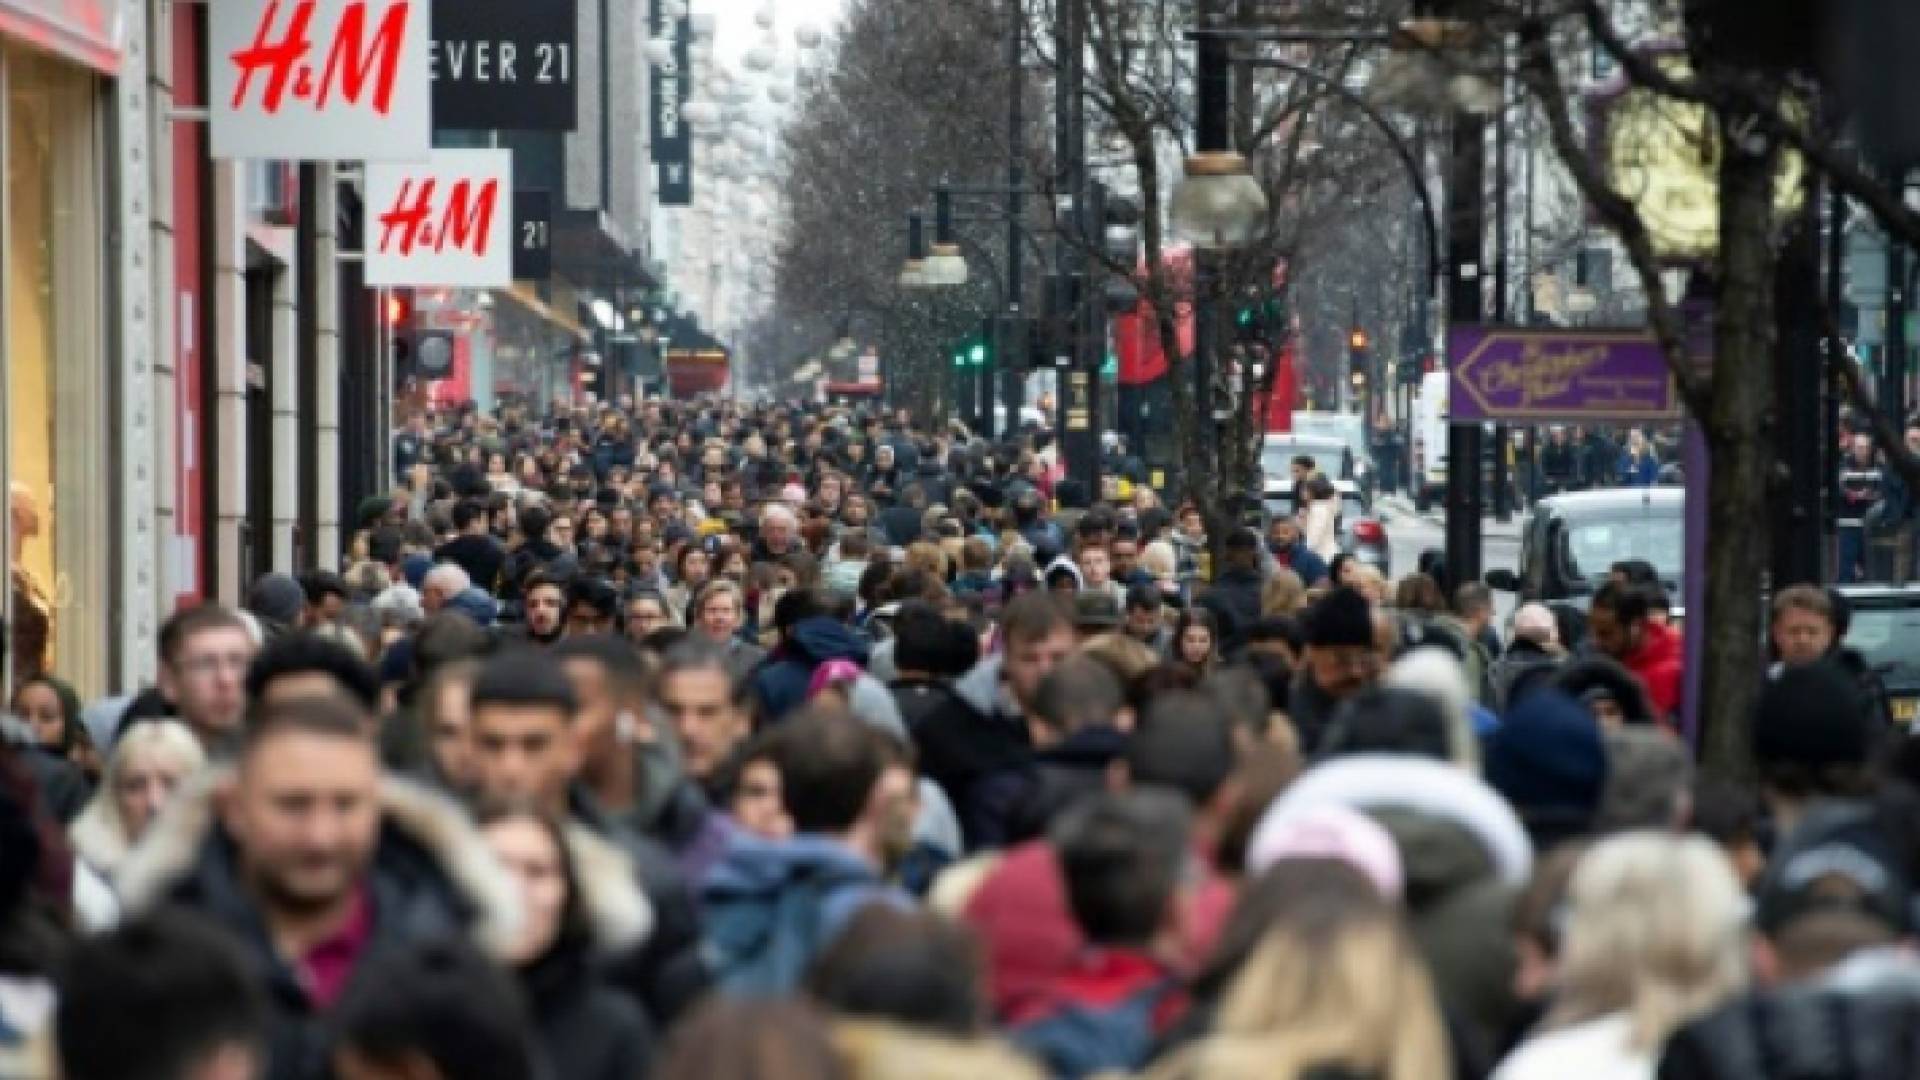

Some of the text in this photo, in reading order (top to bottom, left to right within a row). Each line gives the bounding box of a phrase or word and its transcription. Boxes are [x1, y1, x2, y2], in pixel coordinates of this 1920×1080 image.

[229, 0, 408, 114] H&M
[535, 43, 570, 82] 21
[378, 177, 498, 257] H&M
[522, 220, 548, 249] 21
